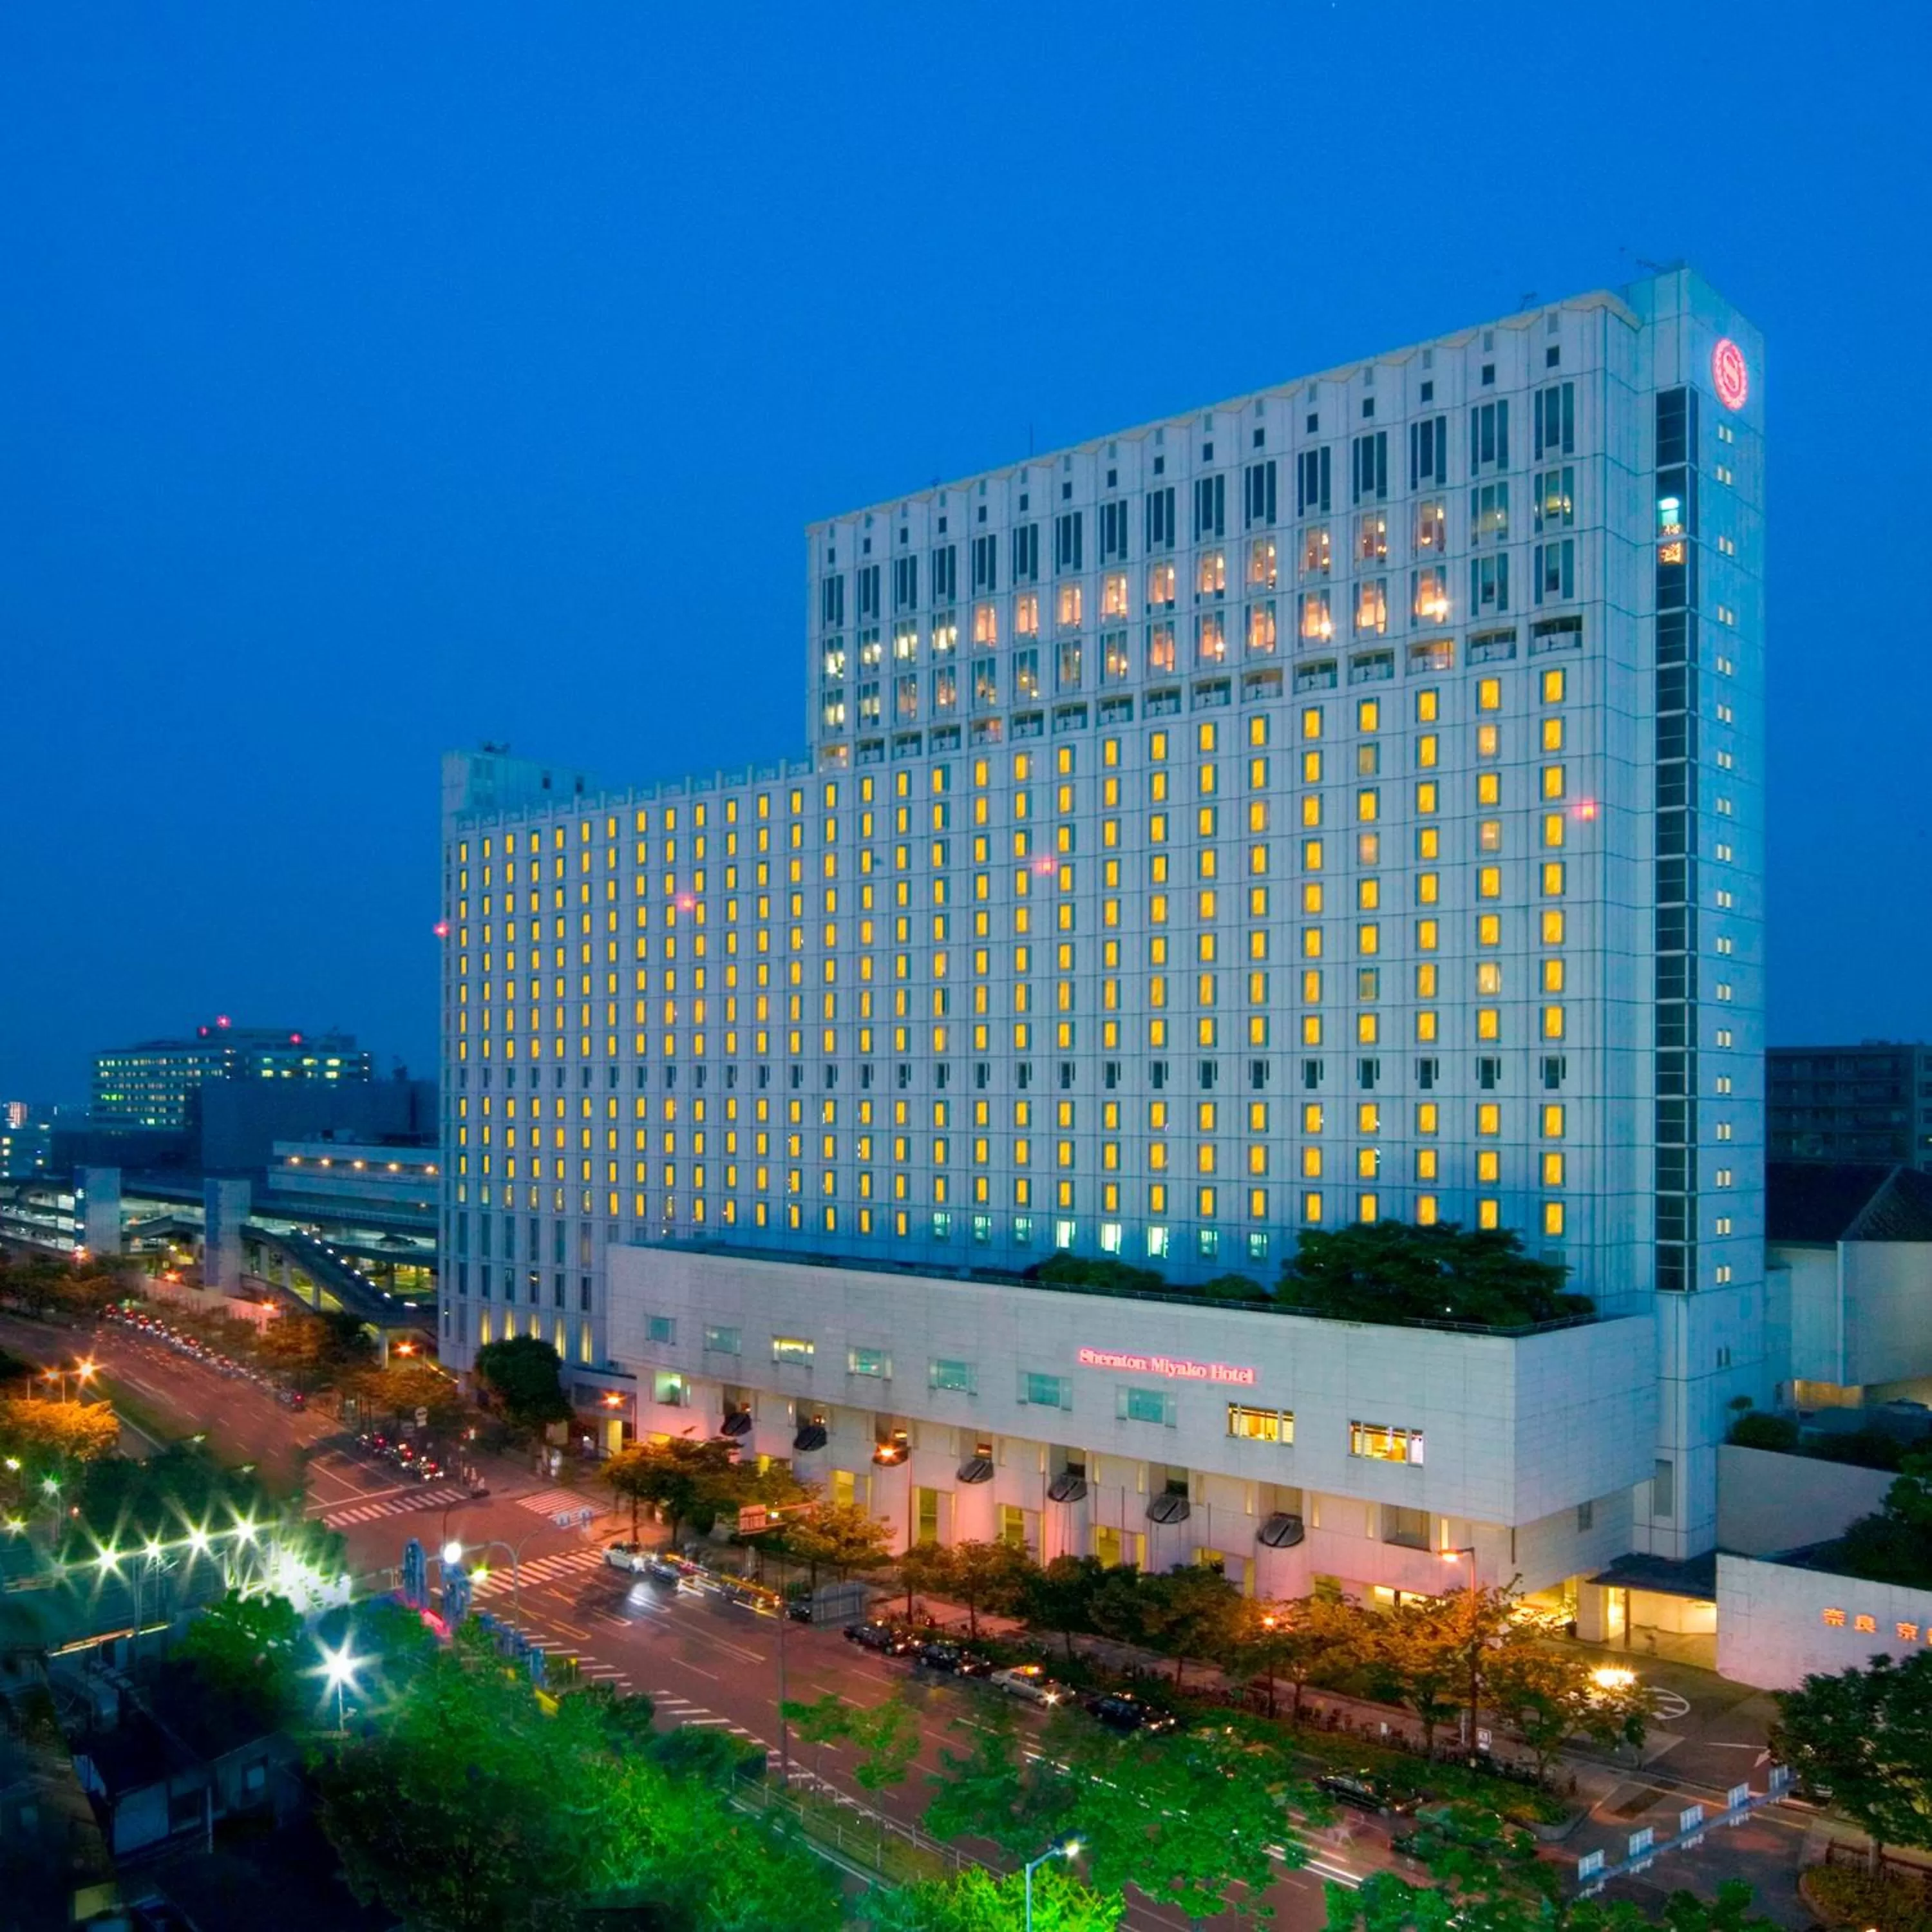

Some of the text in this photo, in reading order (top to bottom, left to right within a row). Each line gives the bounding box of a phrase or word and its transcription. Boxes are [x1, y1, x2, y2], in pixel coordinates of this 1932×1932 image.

[1079, 1349, 1255, 1383] Sheraton Miyako Hotel
[1896, 1622, 1932, 1645] 京
